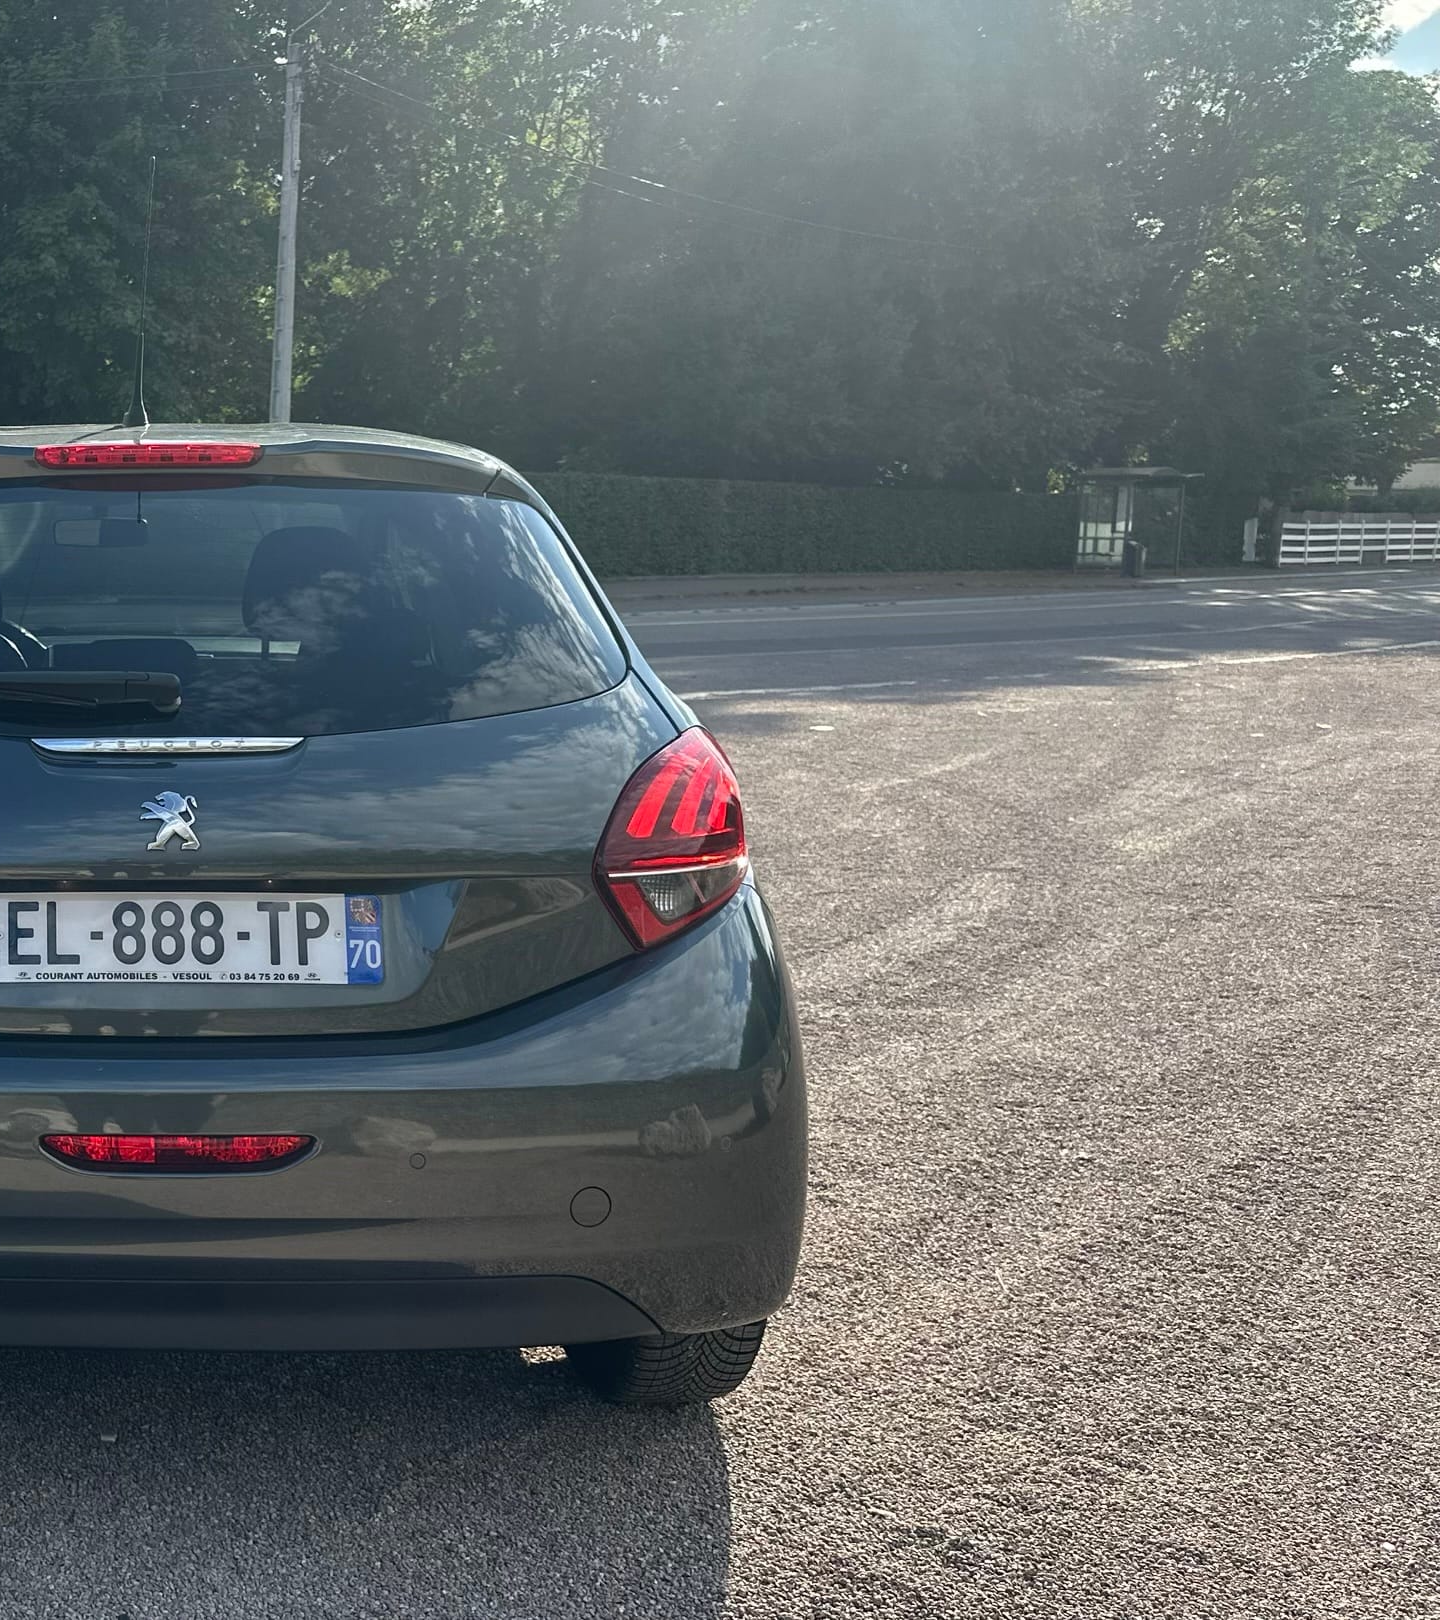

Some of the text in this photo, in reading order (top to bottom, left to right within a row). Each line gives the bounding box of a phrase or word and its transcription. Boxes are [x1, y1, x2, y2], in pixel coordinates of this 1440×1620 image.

[93, 738, 245, 749] PEUGEOT
[7, 901, 330, 966] EL-888-TP
[349, 939, 382, 969] 70
[35, 972, 83, 980] COURANT
[86, 972, 158, 980] AUTOMOBILES
[172, 972, 213, 981] VESOUL
[229, 973, 242, 981] 03
[244, 973, 257, 981] 84
[258, 973, 271, 981] 75
[273, 973, 285, 981] 20
[287, 973, 300, 981] 69
